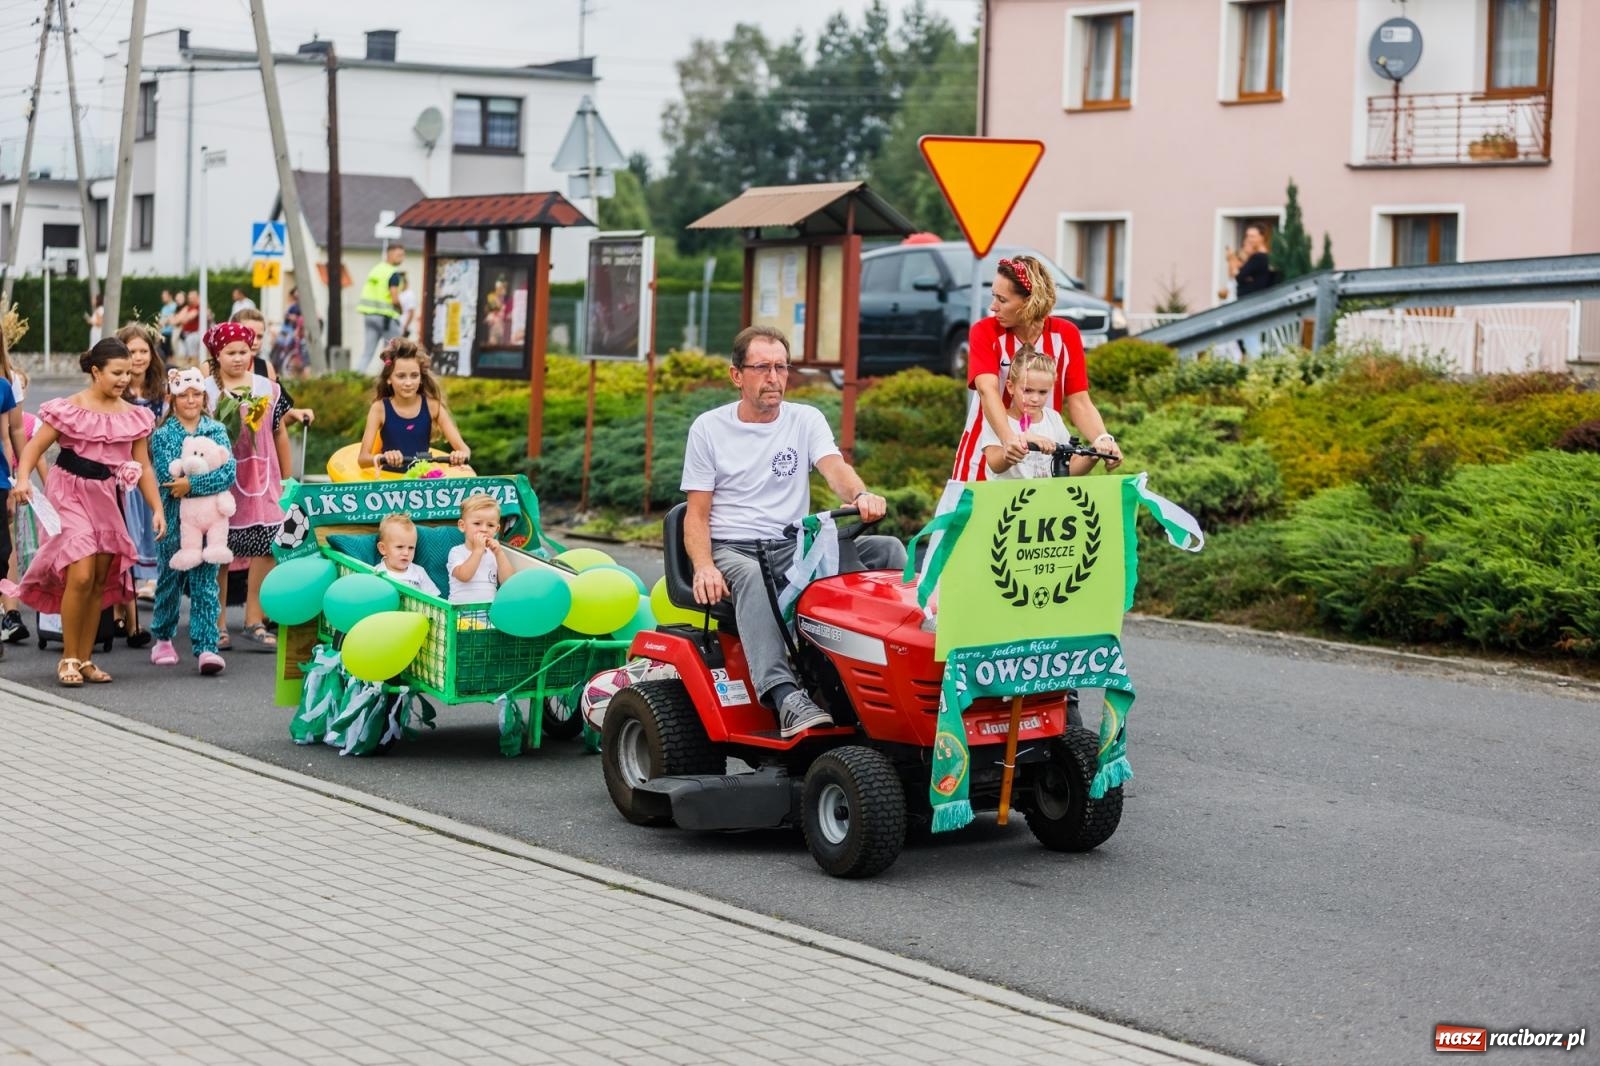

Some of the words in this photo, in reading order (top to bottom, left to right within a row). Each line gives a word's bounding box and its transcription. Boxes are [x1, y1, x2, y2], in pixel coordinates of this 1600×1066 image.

[320, 483, 373, 492] Dumni
[378, 482, 398, 492] po
[304, 493, 358, 516] LKS
[427, 509, 461, 519] pora
[1017, 515, 1077, 543] LKS
[1016, 545, 1075, 561] OWSISZCZE
[1033, 563, 1055, 575] 1913
[988, 645, 1025, 659] jeden
[1030, 640, 1059, 653] klub
[976, 646, 1127, 686] OWSISZCZ
[1014, 681, 1029, 693] od
[1081, 675, 1097, 685] aż
[1102, 678, 1120, 688] po
[981, 716, 1041, 735] Jonred
